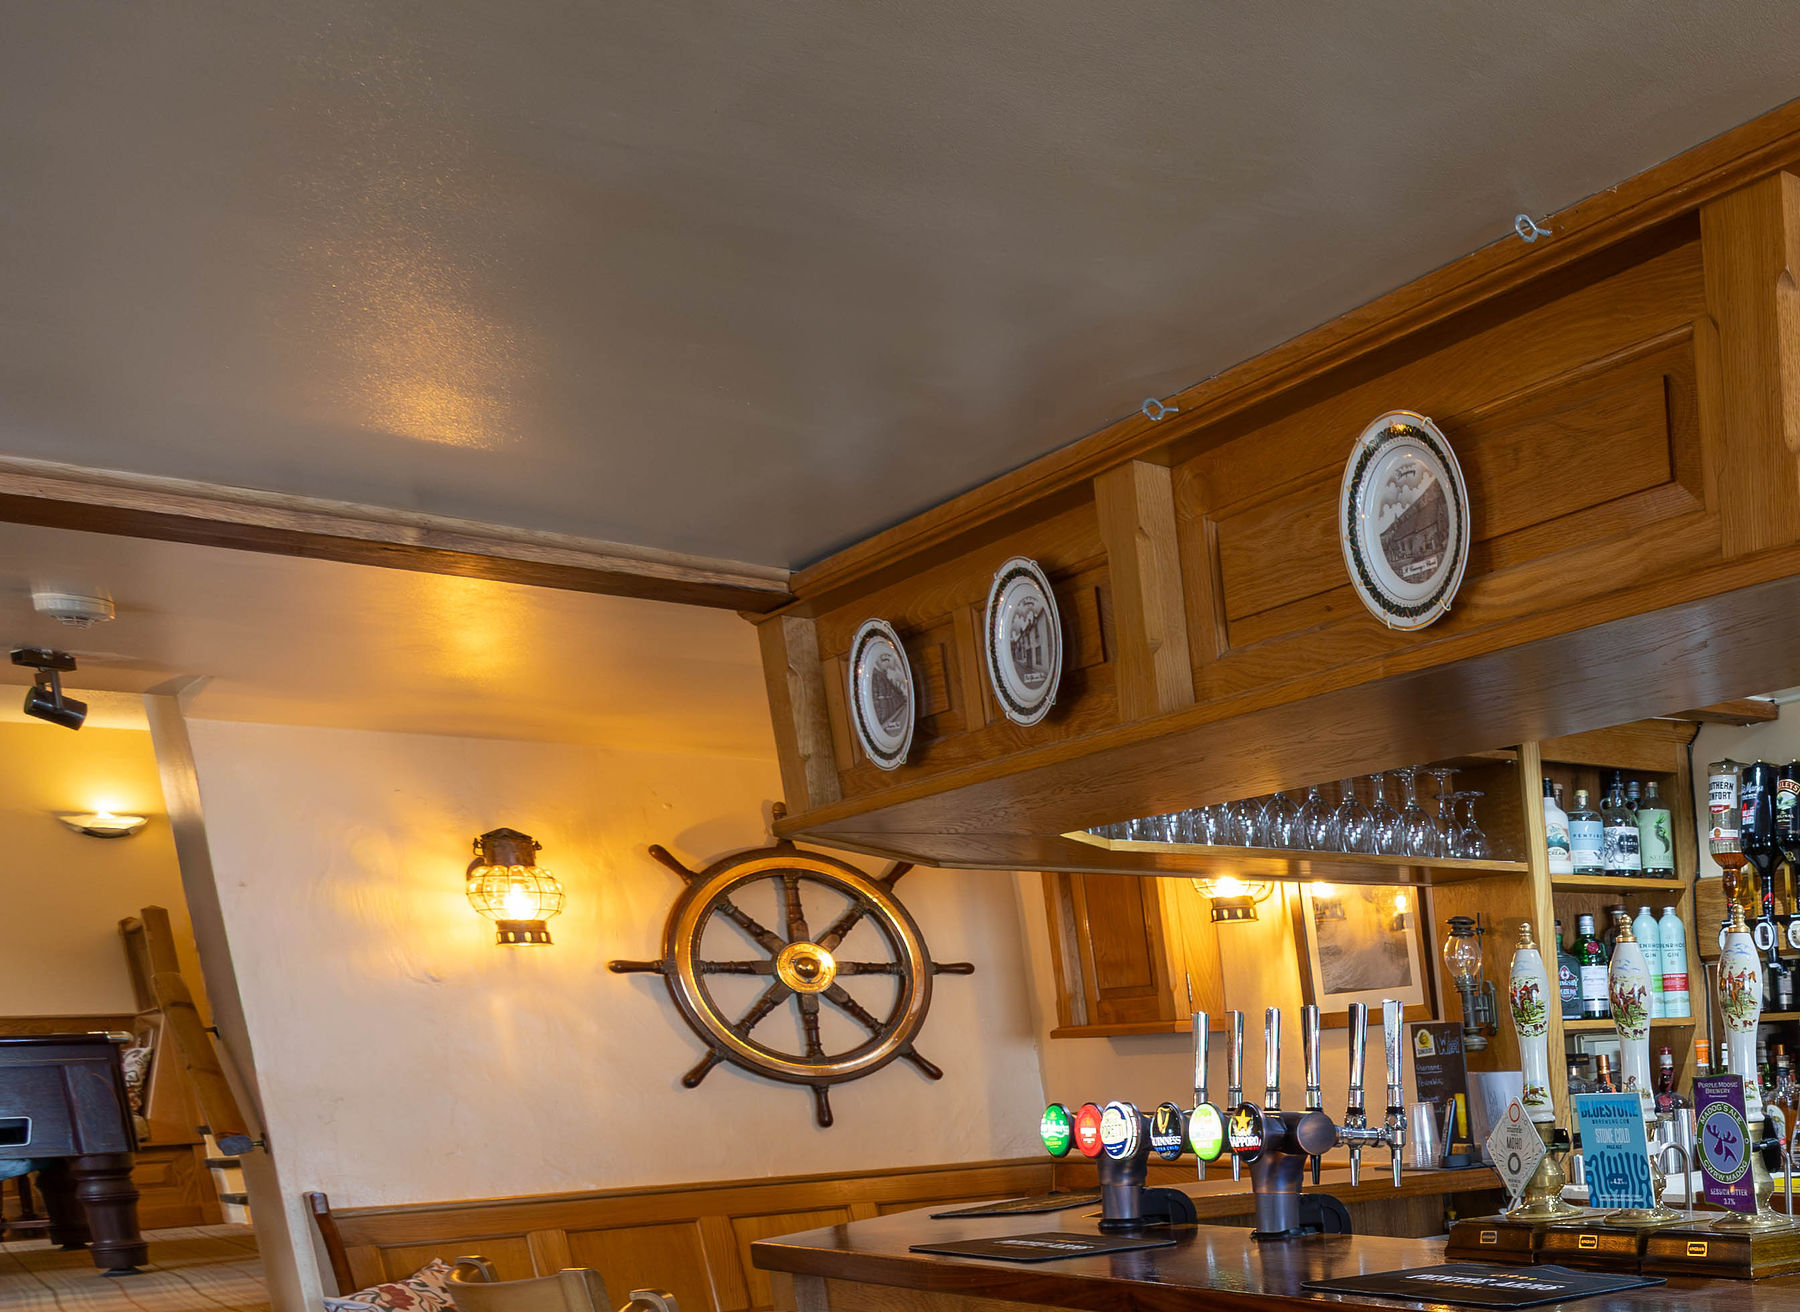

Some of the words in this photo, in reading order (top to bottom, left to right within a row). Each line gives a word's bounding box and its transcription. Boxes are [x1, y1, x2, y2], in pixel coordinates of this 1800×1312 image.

[1580, 1100, 1639, 1118] BLUESTONE
[1701, 1103, 1729, 1125] MADOG'S
[1729, 1107, 1742, 1124] ALE
[1595, 1127, 1614, 1144] STONE
[1615, 1127, 1631, 1144] COLD
[1704, 1159, 1726, 1181] CWRW
[1726, 1161, 1748, 1182] MADOG
[1405, 1273, 1498, 1287] PENTRE
[1499, 1277, 1565, 1291] ARMS
